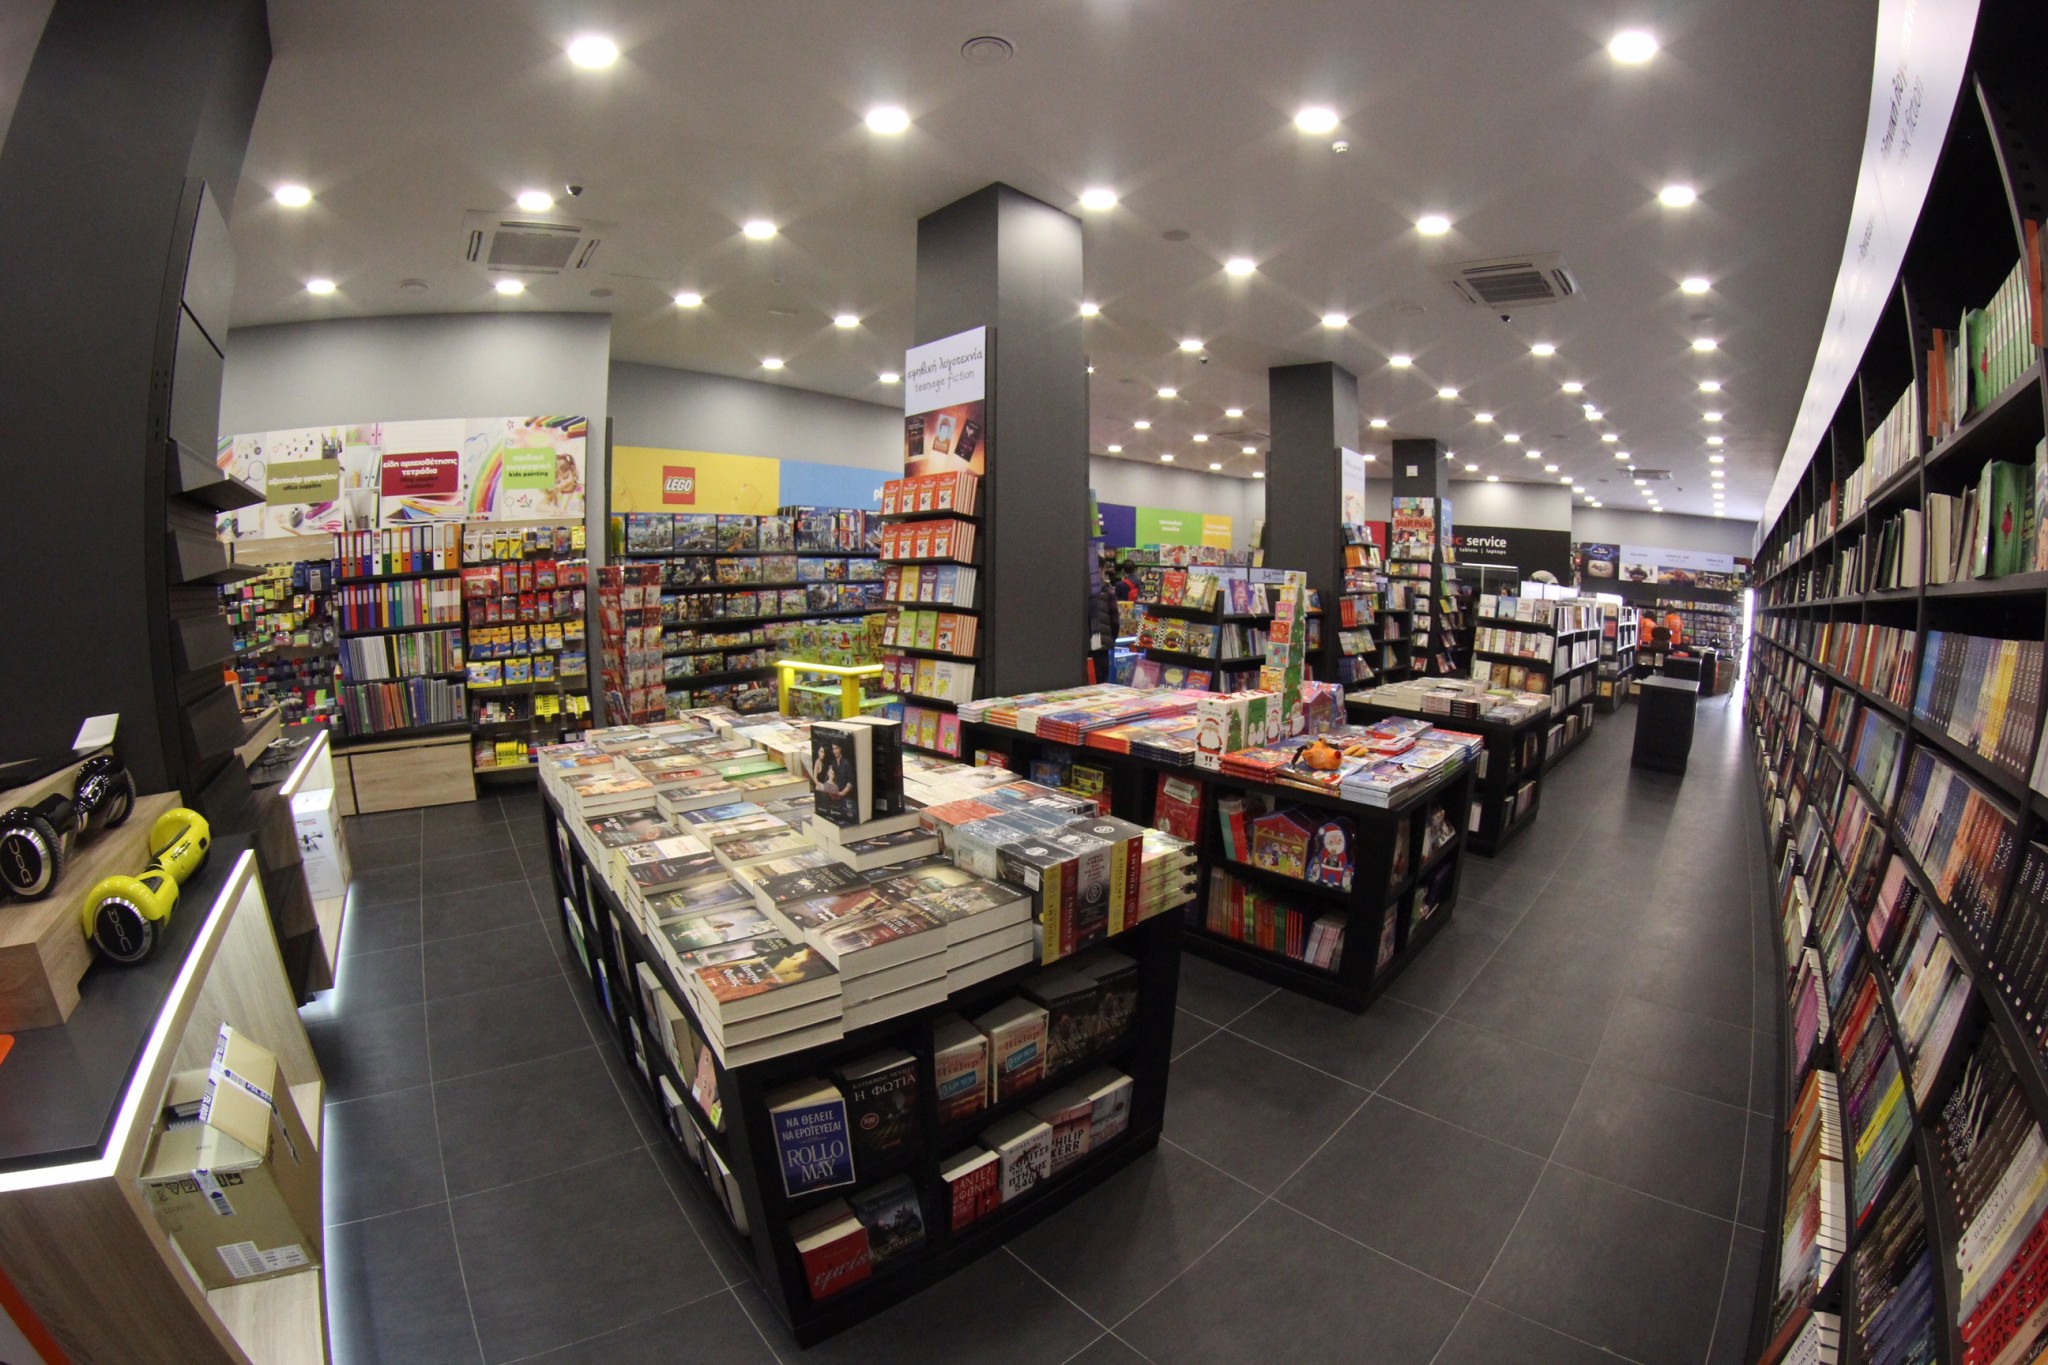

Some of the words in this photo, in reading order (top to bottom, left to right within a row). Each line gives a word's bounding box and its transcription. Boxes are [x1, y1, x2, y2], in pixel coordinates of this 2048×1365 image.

[915, 378, 945, 393] teenage
[947, 370, 974, 389] fiction
[402, 467, 437, 476] τετράδια
[666, 478, 692, 492] LEGO
[1466, 536, 1507, 548] service
[855, 1090, 865, 1102] Η
[871, 1074, 916, 1096] ΦΩΤΙΑ
[786, 1117, 799, 1128] ΝΑ
[801, 1110, 834, 1125] ΘΕΛΕΙΣ
[783, 1131, 794, 1141] ΝΑ
[794, 1121, 841, 1139] ΕΡΩΤΕΥΕΣΑΙ
[786, 1140, 844, 1168] ROLLO
[1009, 1146, 1048, 1172] ΚΟΡΙΤΣΙ
[1051, 1141, 1079, 1158] KERR
[802, 1158, 835, 1182] MAY
